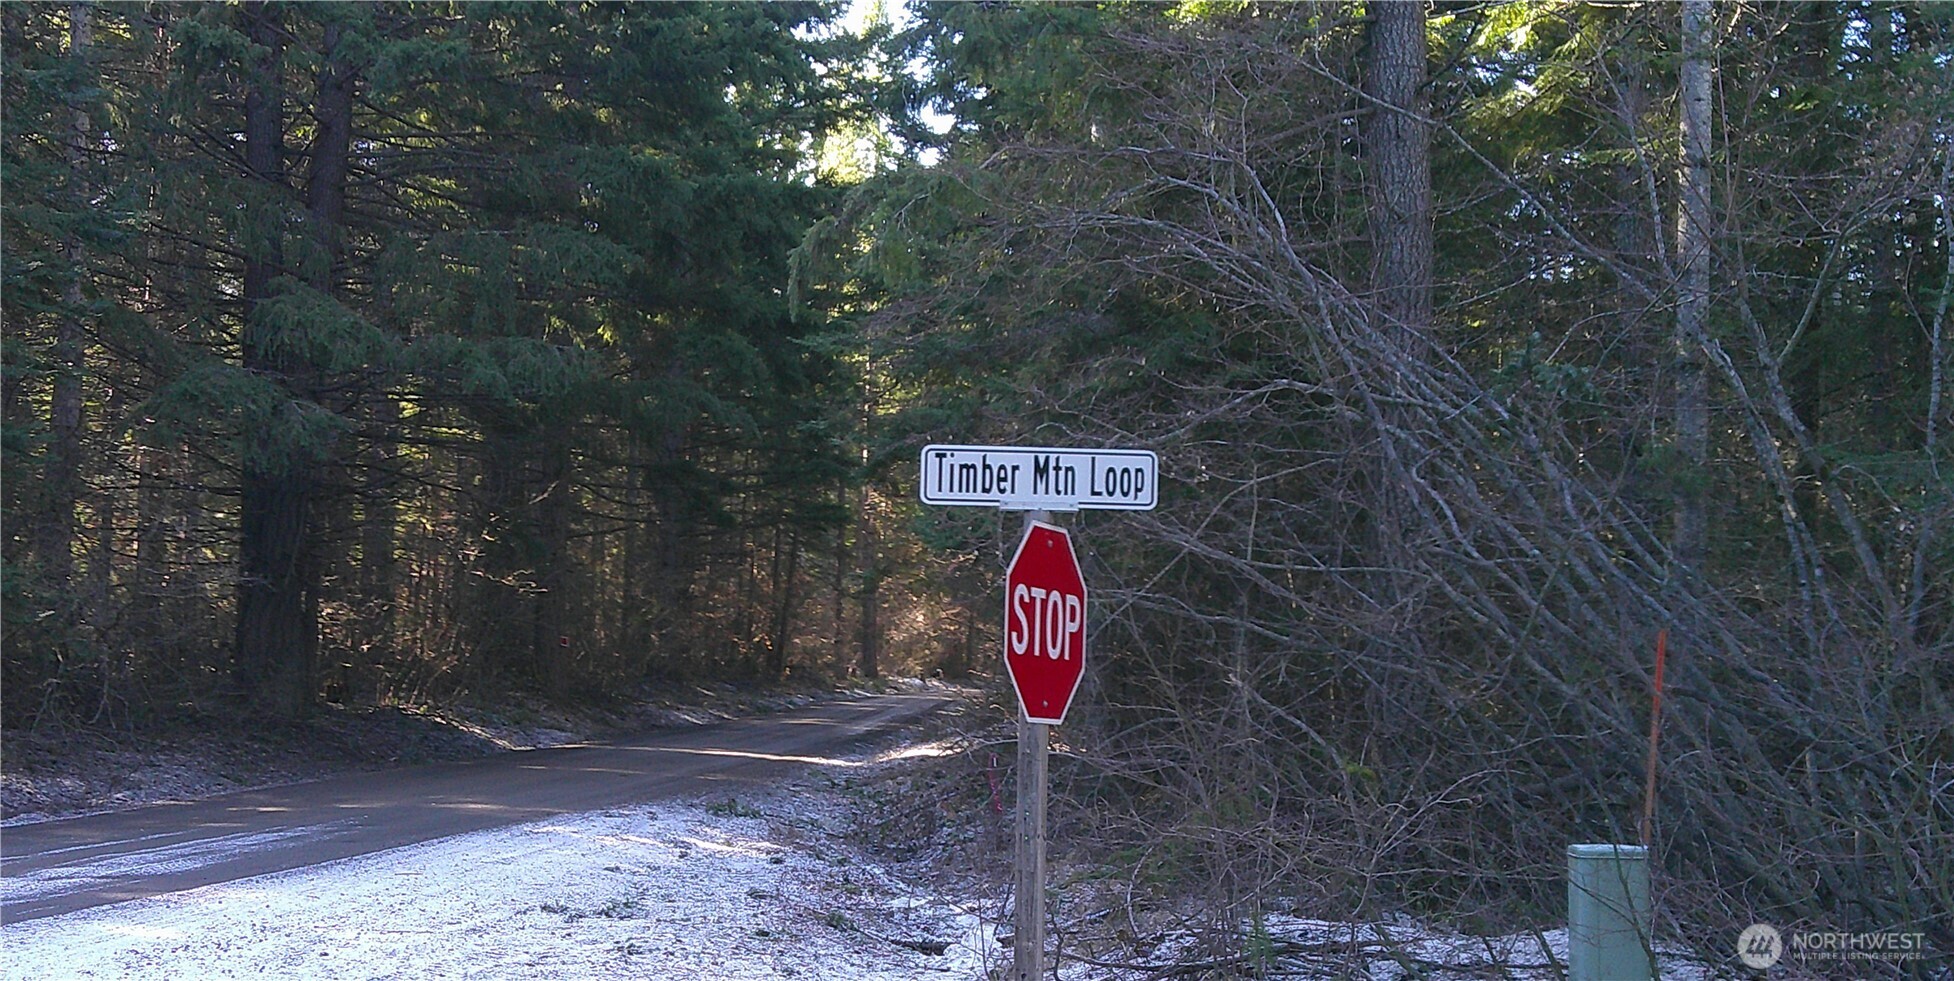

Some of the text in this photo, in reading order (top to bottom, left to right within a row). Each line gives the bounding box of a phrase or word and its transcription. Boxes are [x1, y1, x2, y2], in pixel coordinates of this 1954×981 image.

[935, 452, 1145, 501] Timber Mtn Loop
[1011, 583, 1081, 661] STOP
